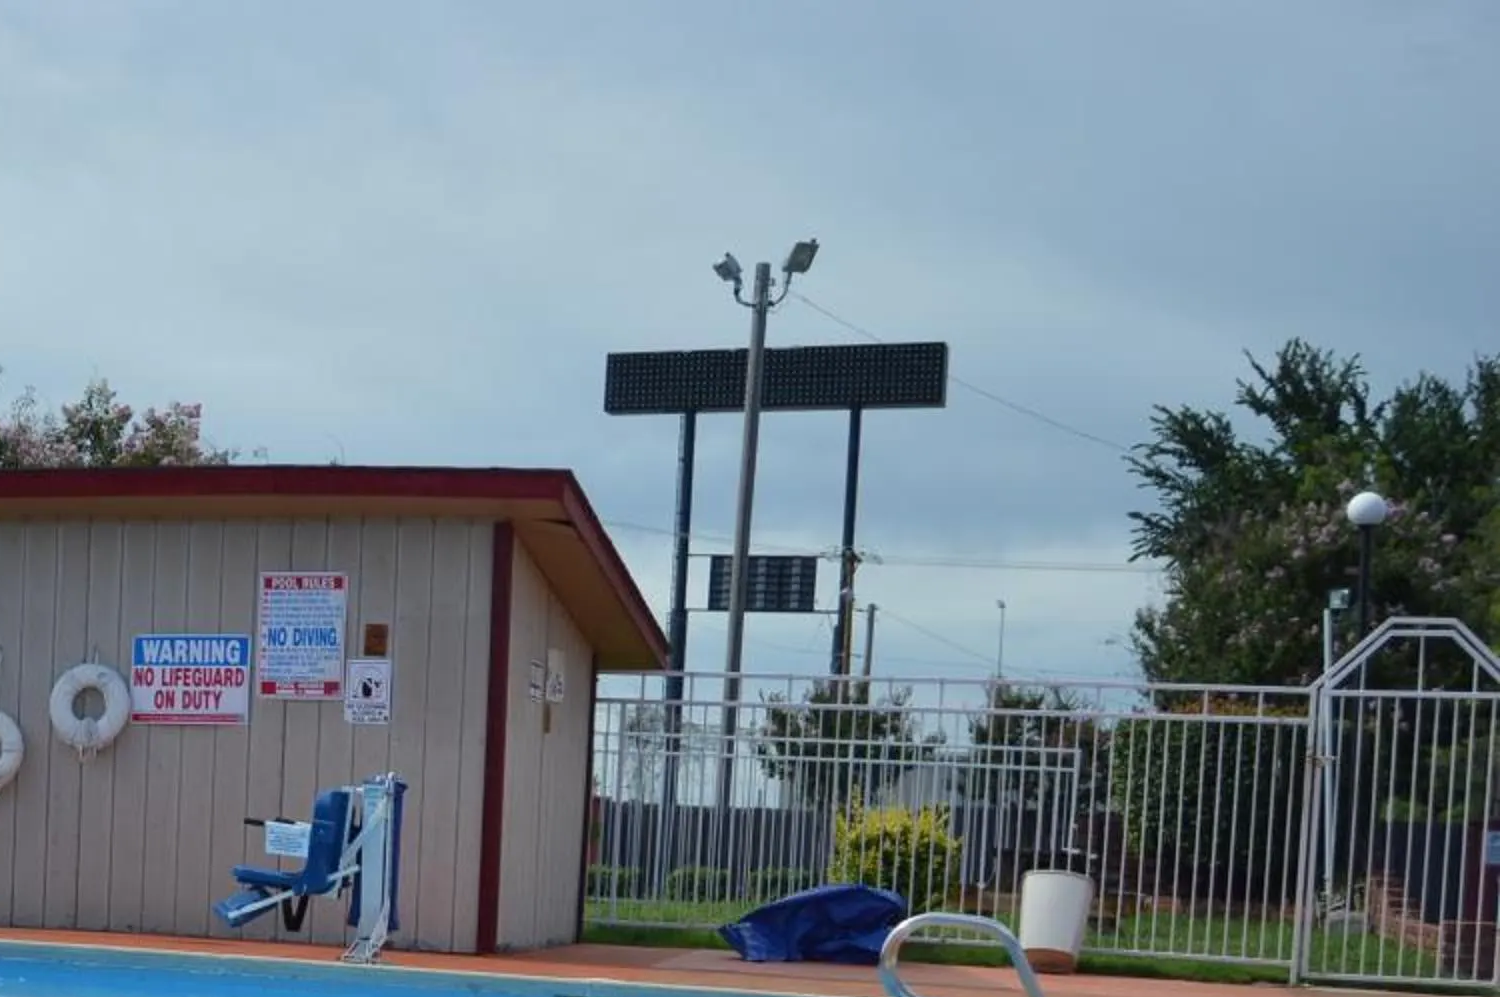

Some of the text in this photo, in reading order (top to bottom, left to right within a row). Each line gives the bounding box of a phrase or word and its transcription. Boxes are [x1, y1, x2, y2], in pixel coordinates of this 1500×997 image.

[272, 577, 336, 590] POOL RULES
[268, 628, 287, 646] NO
[142, 639, 241, 664] WARNING
[134, 667, 245, 688] NO LIFEGUARD
[154, 690, 223, 710] ON DUTY
